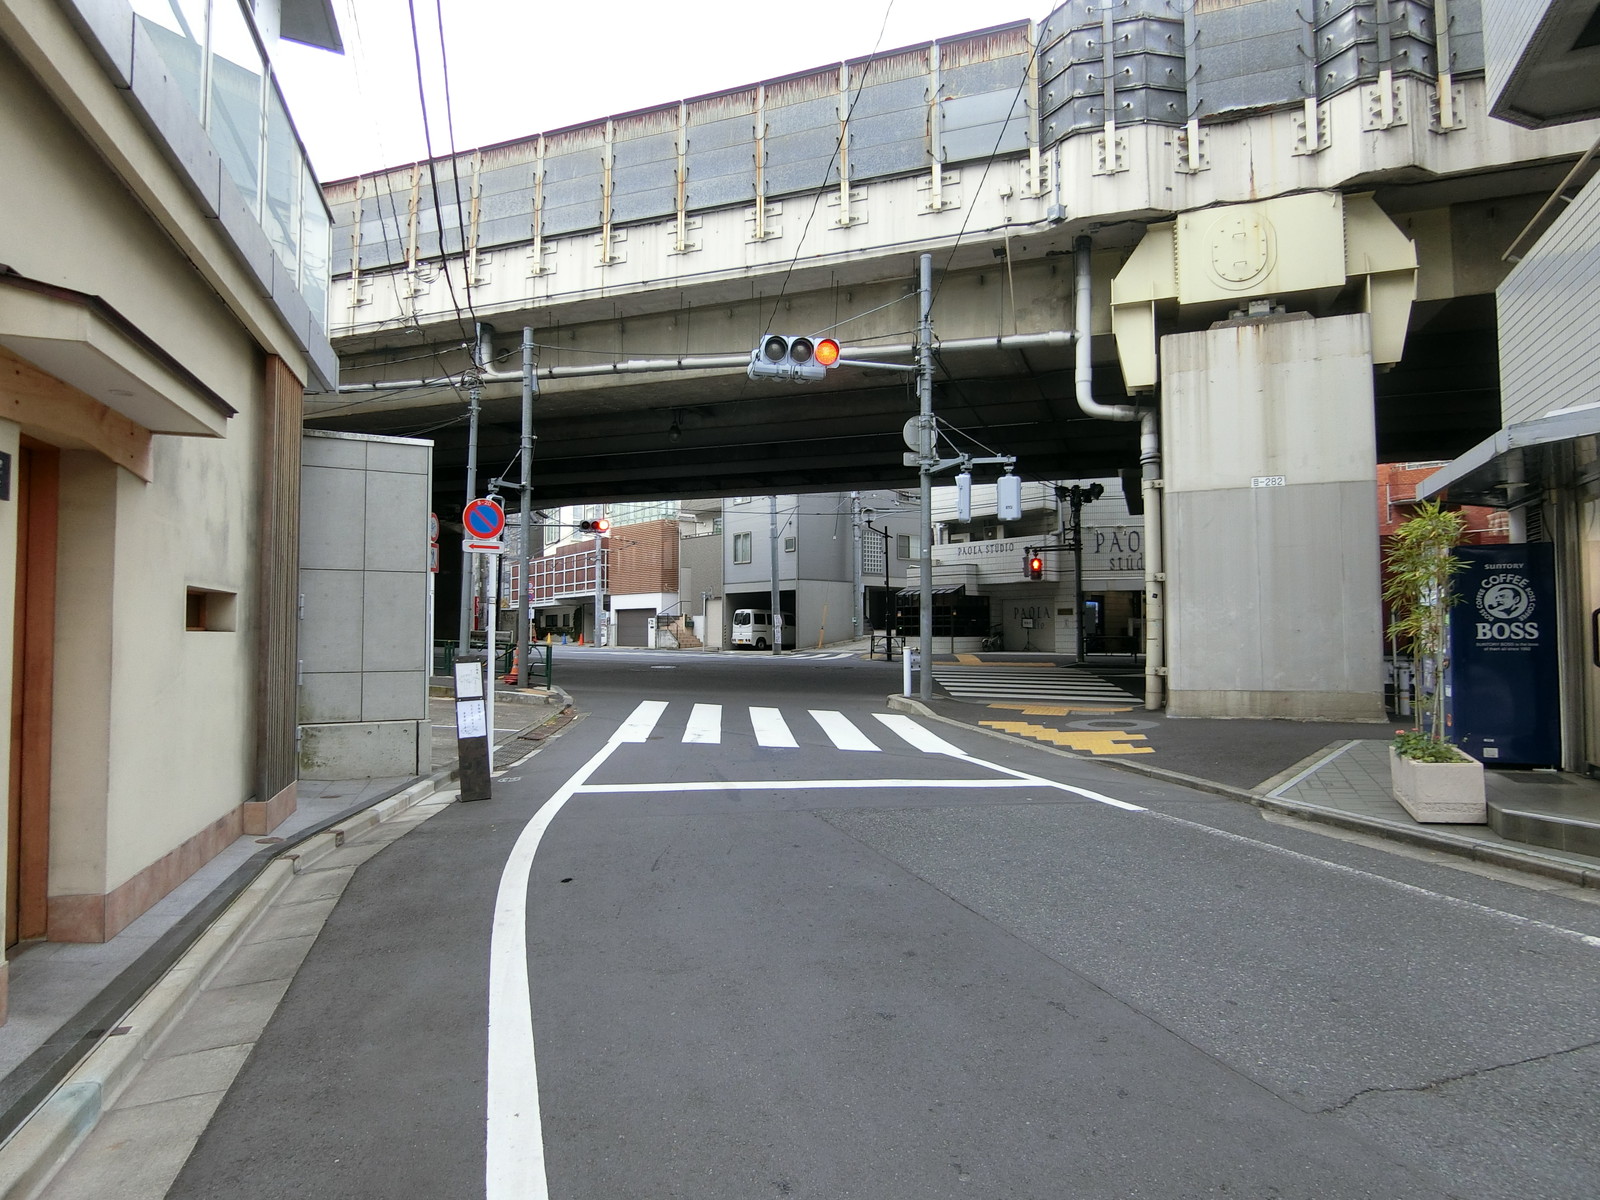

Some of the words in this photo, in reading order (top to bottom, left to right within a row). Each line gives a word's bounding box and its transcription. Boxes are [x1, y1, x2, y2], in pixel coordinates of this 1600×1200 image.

[957, 545, 983, 556] PAOLA
[985, 543, 1014, 554] STUDIO
[1481, 573, 1531, 588] COFFEE
[1524, 587, 1537, 602] BOSS
[1013, 606, 1051, 619] PAOLA
[1479, 608, 1495, 622] BOSS
[1475, 622, 1540, 640] BOSS
